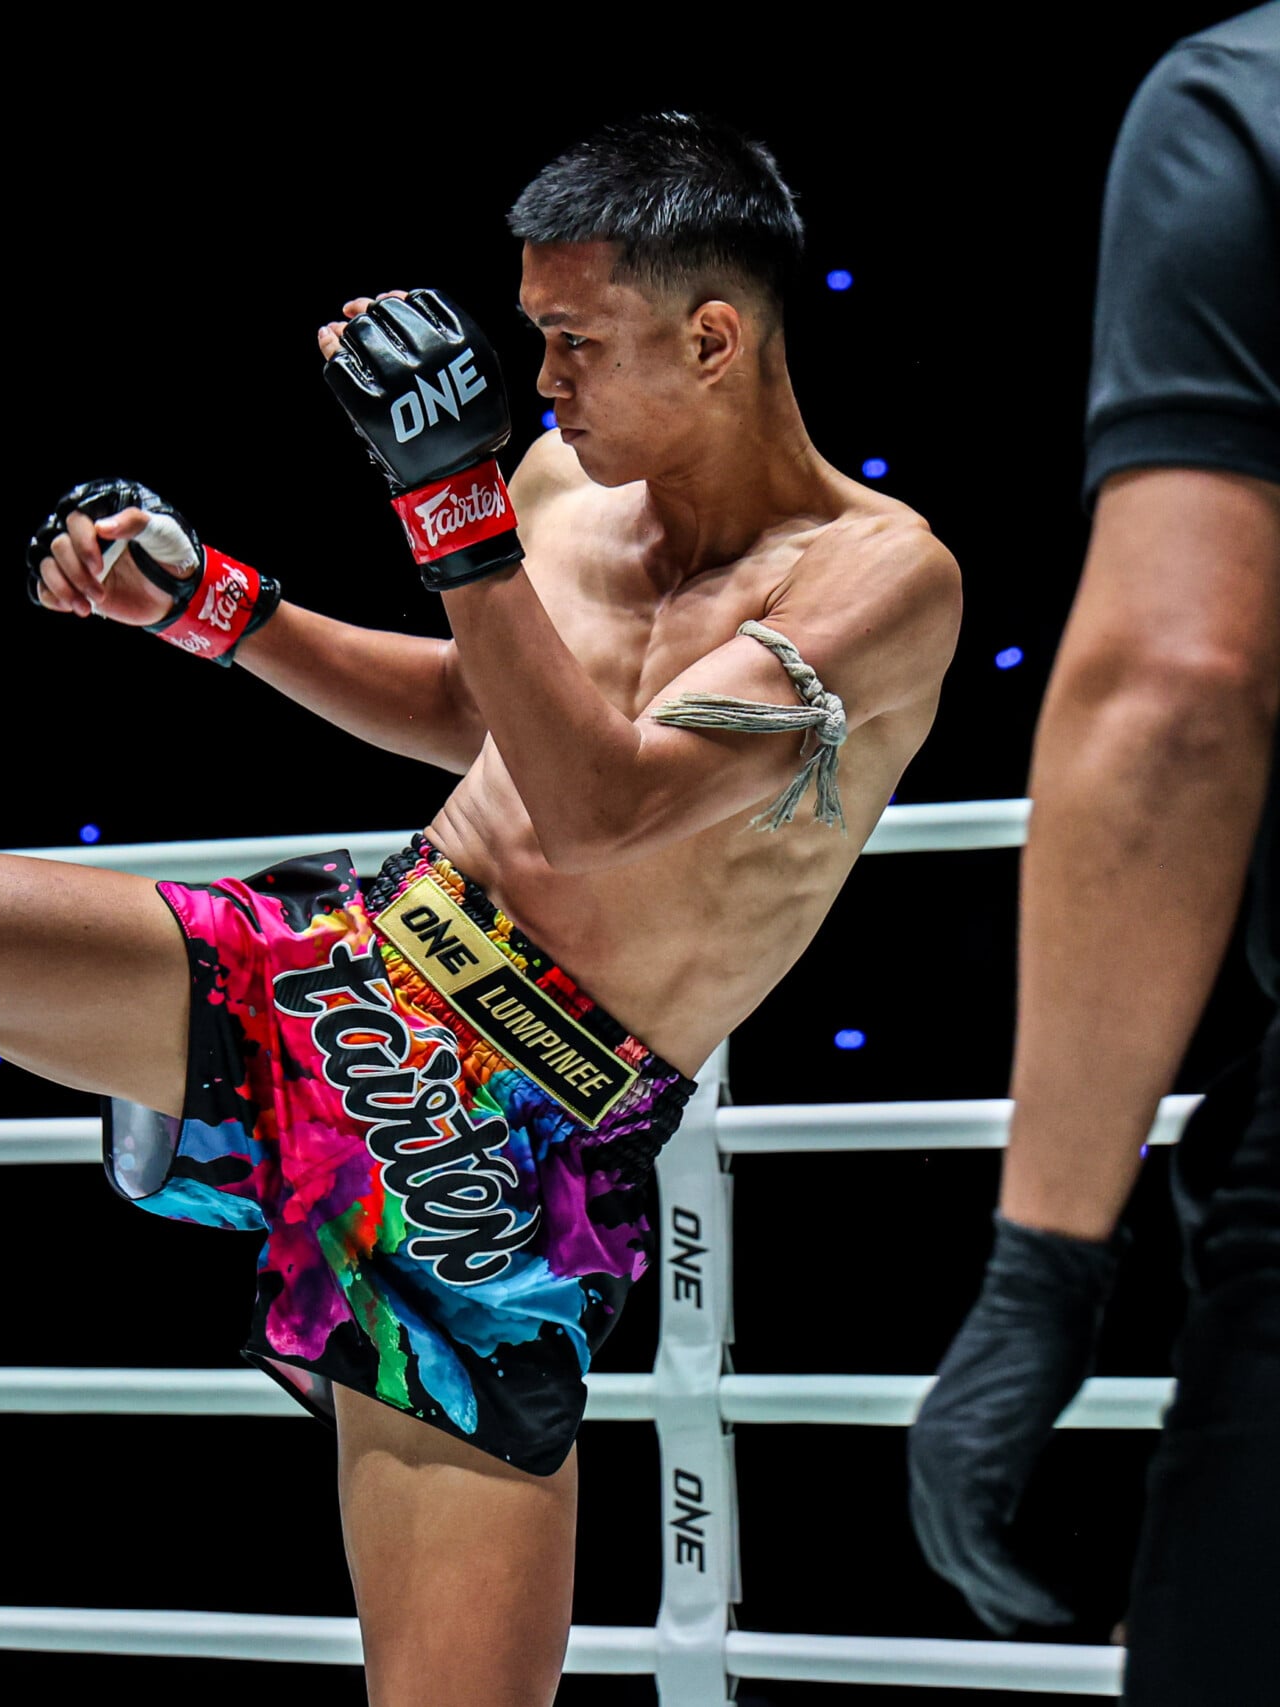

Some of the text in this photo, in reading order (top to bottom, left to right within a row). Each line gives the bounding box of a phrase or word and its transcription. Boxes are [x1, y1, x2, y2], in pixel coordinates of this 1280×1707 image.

[390, 348, 487, 443] ONE
[415, 484, 505, 547] Fairtex
[400, 906, 613, 1097] ONE LUMPINEE
[668, 1205, 709, 1309] ONE
[668, 1468, 711, 1572] ONE
